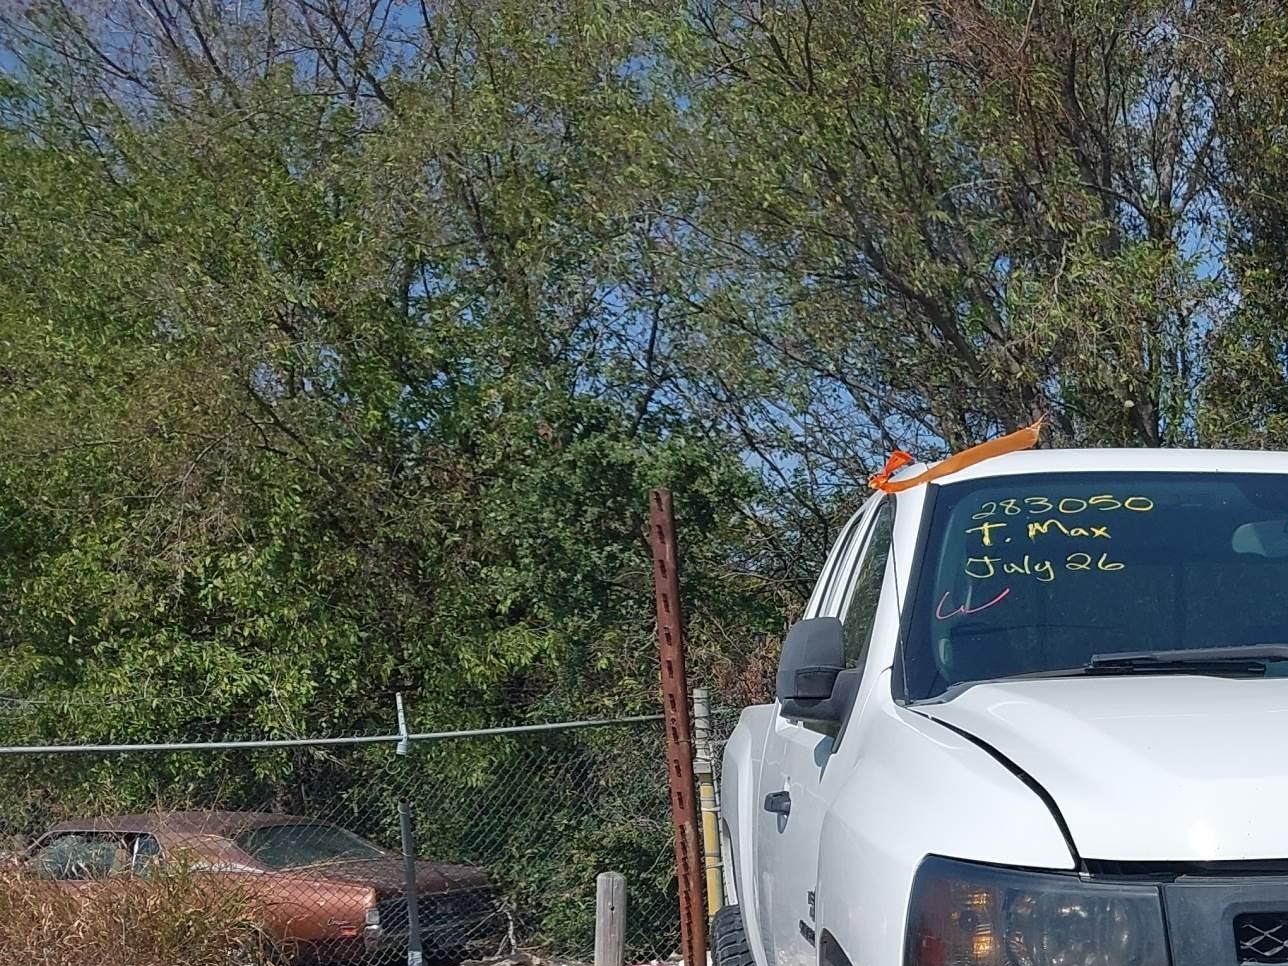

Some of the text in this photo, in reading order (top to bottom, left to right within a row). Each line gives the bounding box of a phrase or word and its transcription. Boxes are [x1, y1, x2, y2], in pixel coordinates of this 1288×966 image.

[971, 494, 1154, 520] 283050
[965, 518, 1112, 546] T. Max
[964, 552, 1126, 582] July 26
